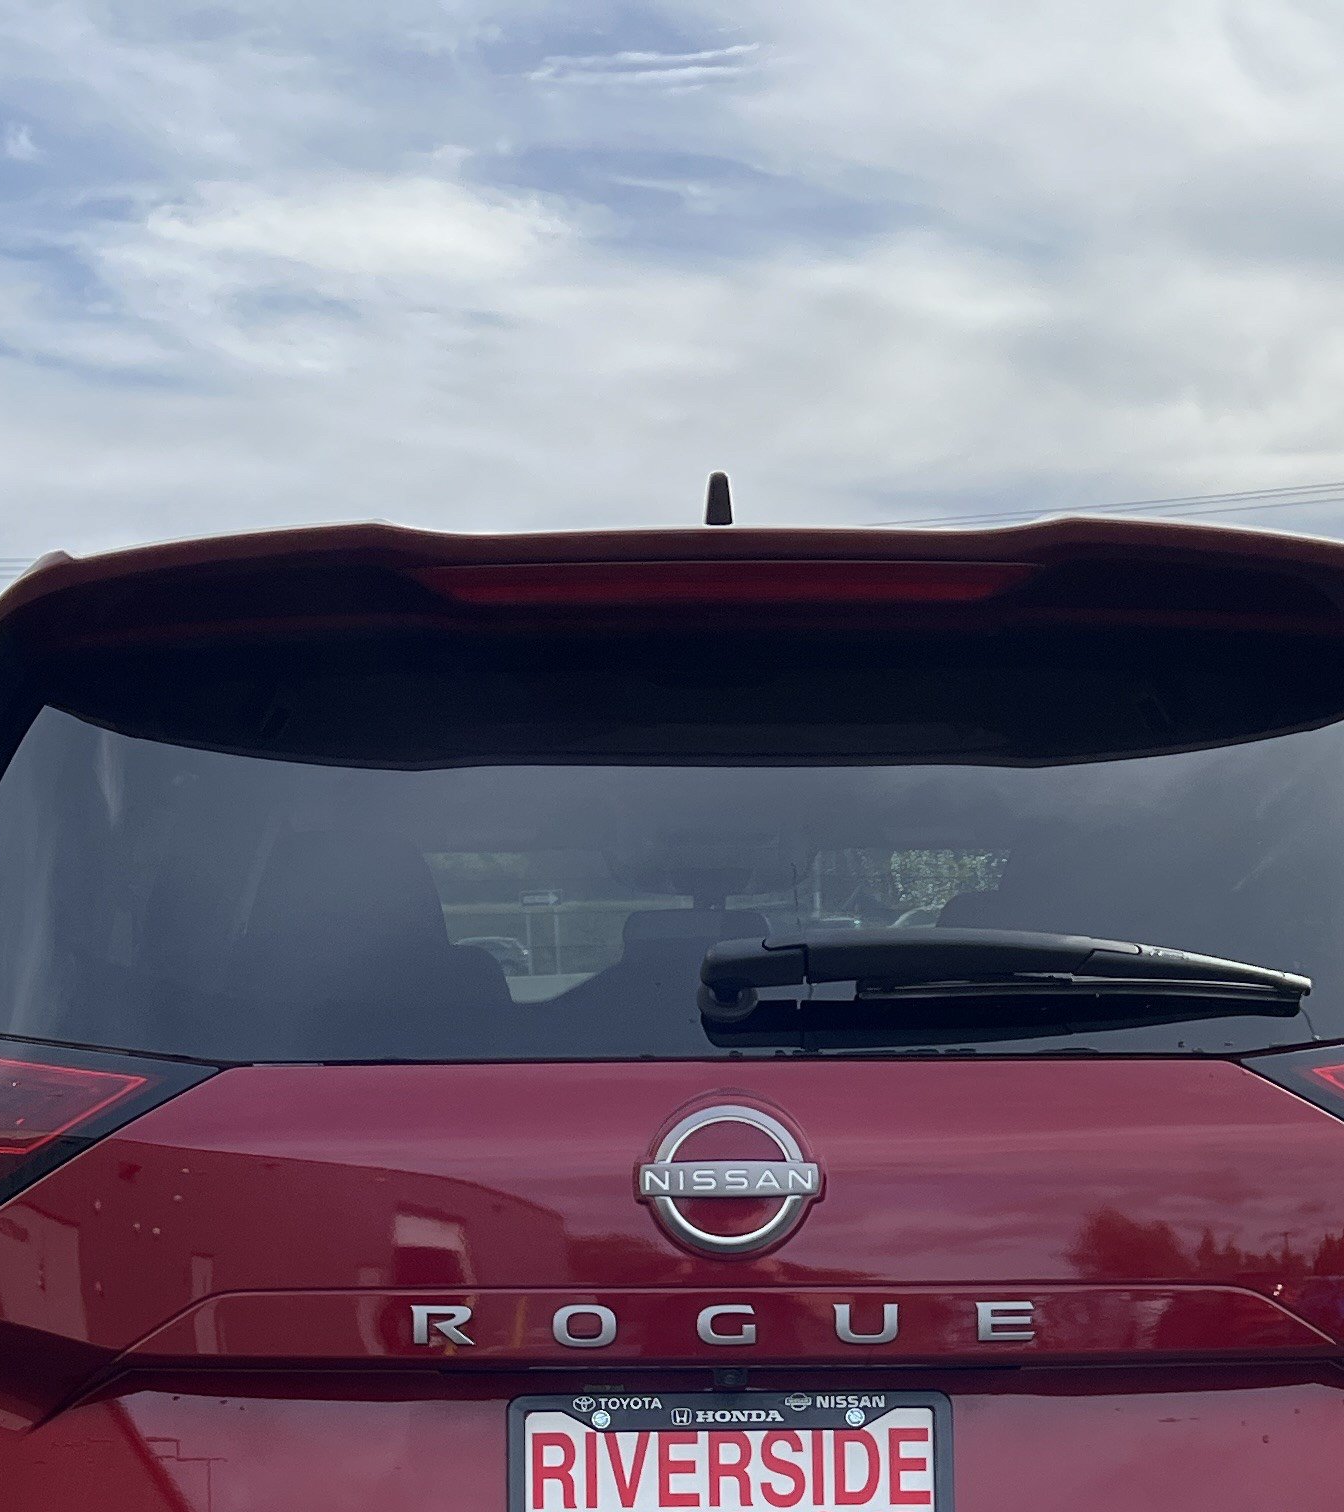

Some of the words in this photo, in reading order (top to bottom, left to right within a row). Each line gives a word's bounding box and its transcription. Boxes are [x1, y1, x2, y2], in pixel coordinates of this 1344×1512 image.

[643, 1169, 813, 1192] NISSAN
[410, 1301, 1037, 1346] ROGUE
[598, 1397, 662, 1410] TOYOTA
[816, 1395, 886, 1409] NISSAN
[695, 1409, 784, 1423] HONDA
[532, 1428, 931, 1509] RIVERSIDE
